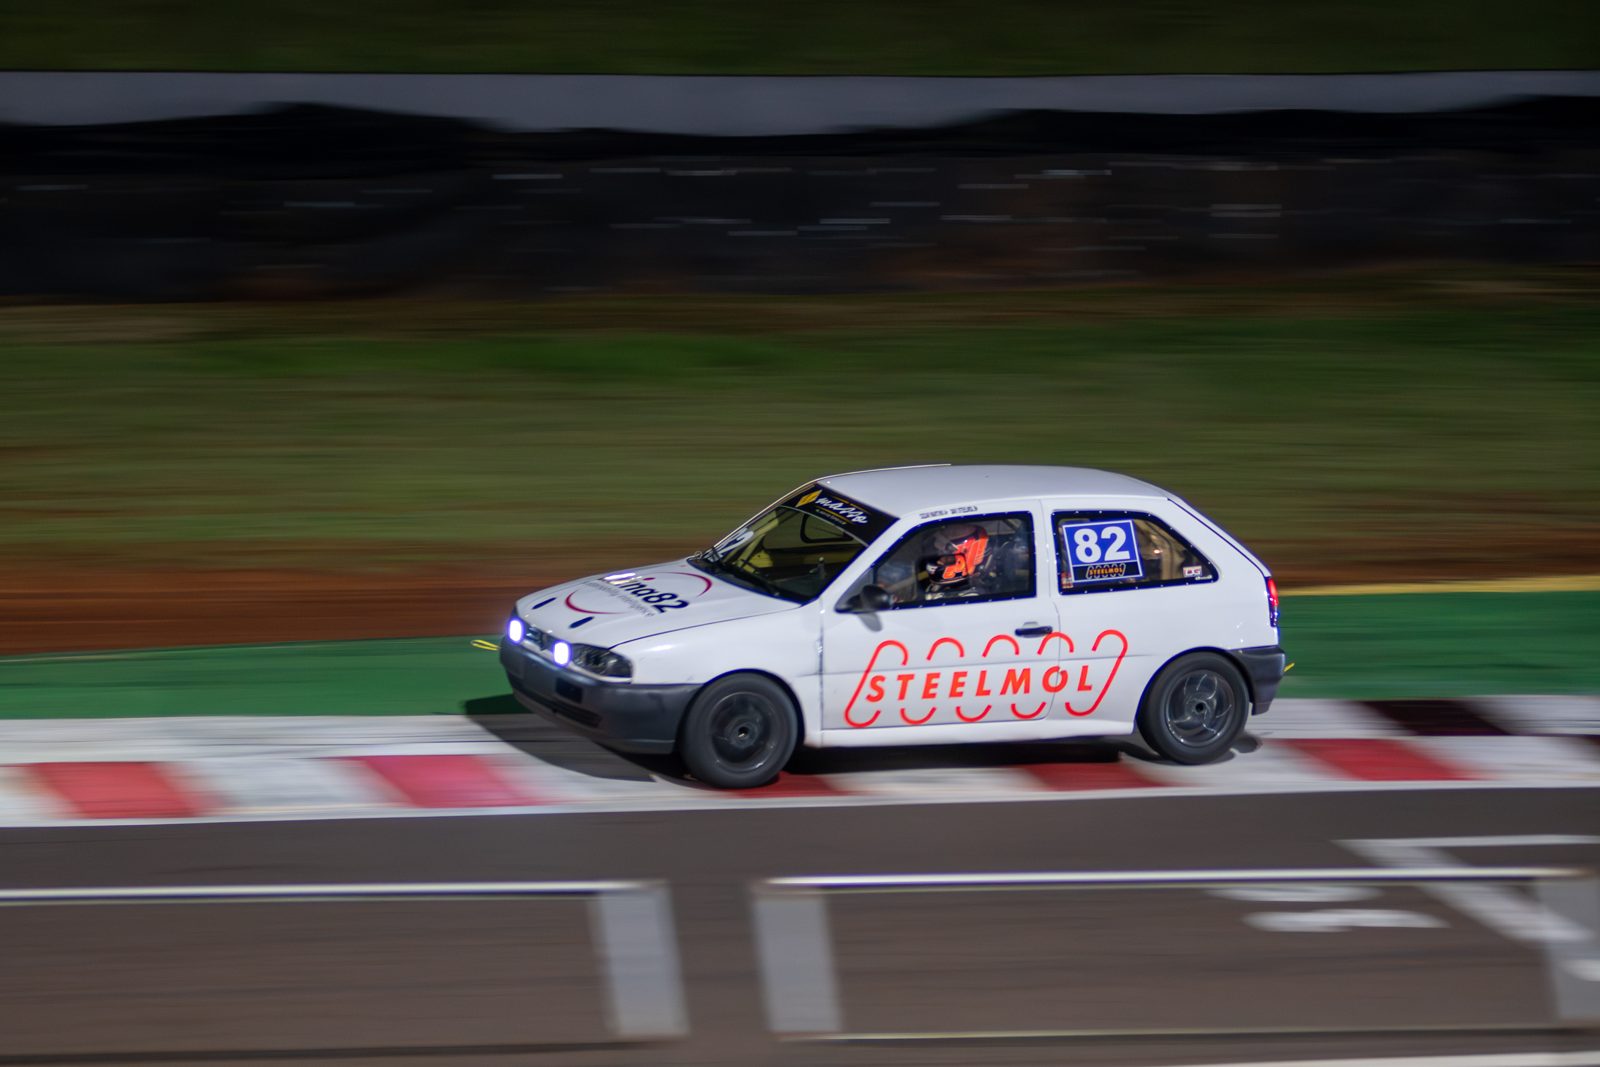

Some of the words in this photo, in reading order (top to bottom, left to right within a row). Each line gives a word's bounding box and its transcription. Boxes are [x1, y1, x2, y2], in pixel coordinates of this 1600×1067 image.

[1073, 526, 1131, 563] 82
[1089, 567, 1123, 575] STEELMOL
[866, 665, 1093, 702] STEELMOL
